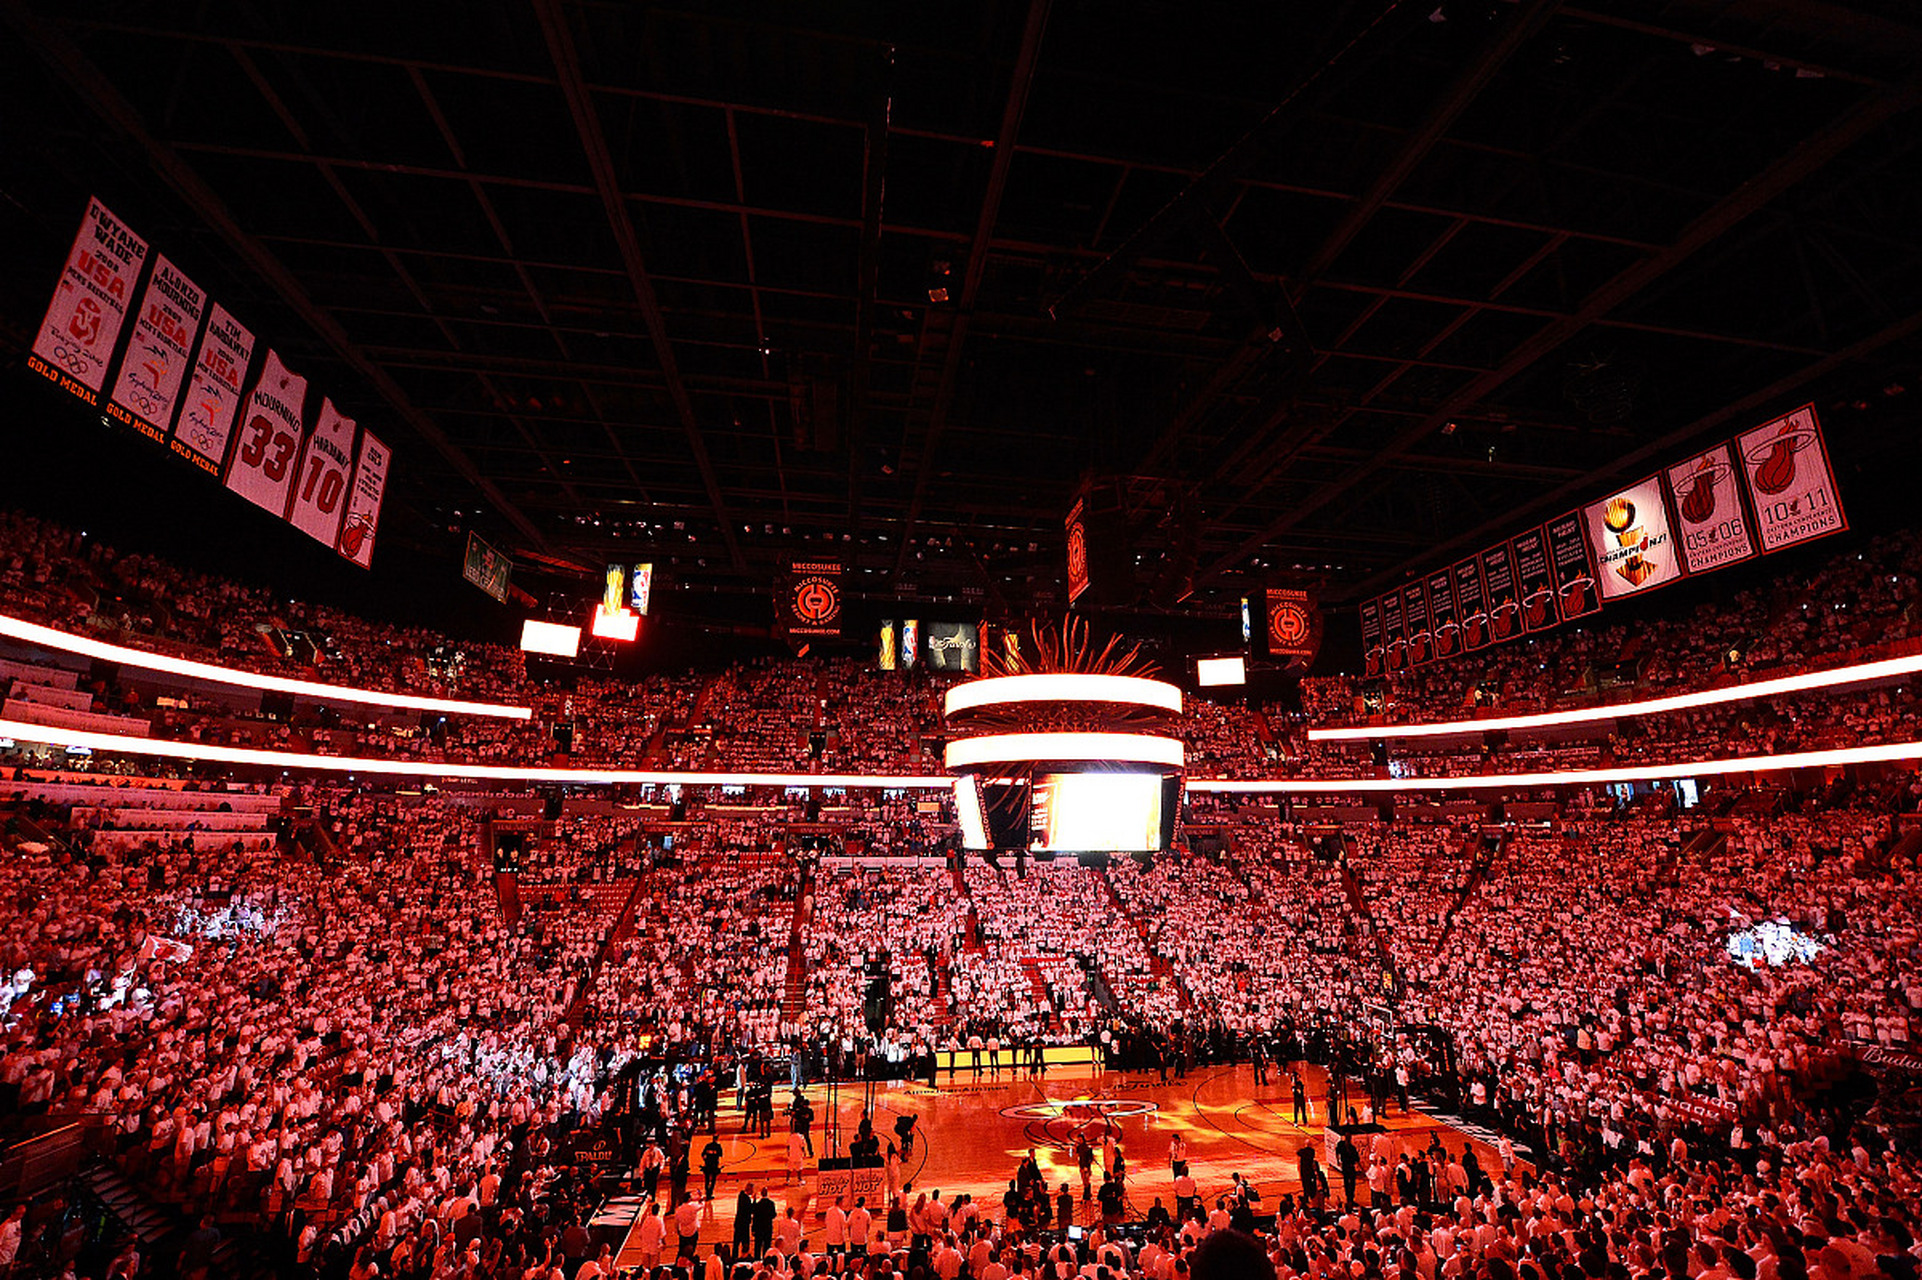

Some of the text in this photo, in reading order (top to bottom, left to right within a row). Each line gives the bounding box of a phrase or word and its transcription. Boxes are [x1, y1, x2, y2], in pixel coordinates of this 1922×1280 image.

[94, 224, 134, 267] WADE
[78, 249, 125, 300] USA
[161, 266, 200, 306] ALONZO
[152, 273, 201, 321] MOURNING
[148, 303, 188, 348] USA
[225, 320, 242, 342] TIM
[27, 356, 97, 406] GOLD MEDAL
[205, 347, 238, 387] USA
[106, 403, 165, 445] GOLD MEDAL
[254, 390, 301, 433] MOURNING
[170, 440, 219, 477] GOLD MEDAL
[241, 414, 296, 483] 33
[302, 455, 344, 515] 10
[1764, 488, 1828, 525] 10 11
[1686, 518, 1743, 550] 05 06
[1767, 515, 1836, 544] CHAMPIONS
[792, 561, 841, 571] MICCOSUKEE
[1690, 543, 1749, 568] CHAMPIONS
